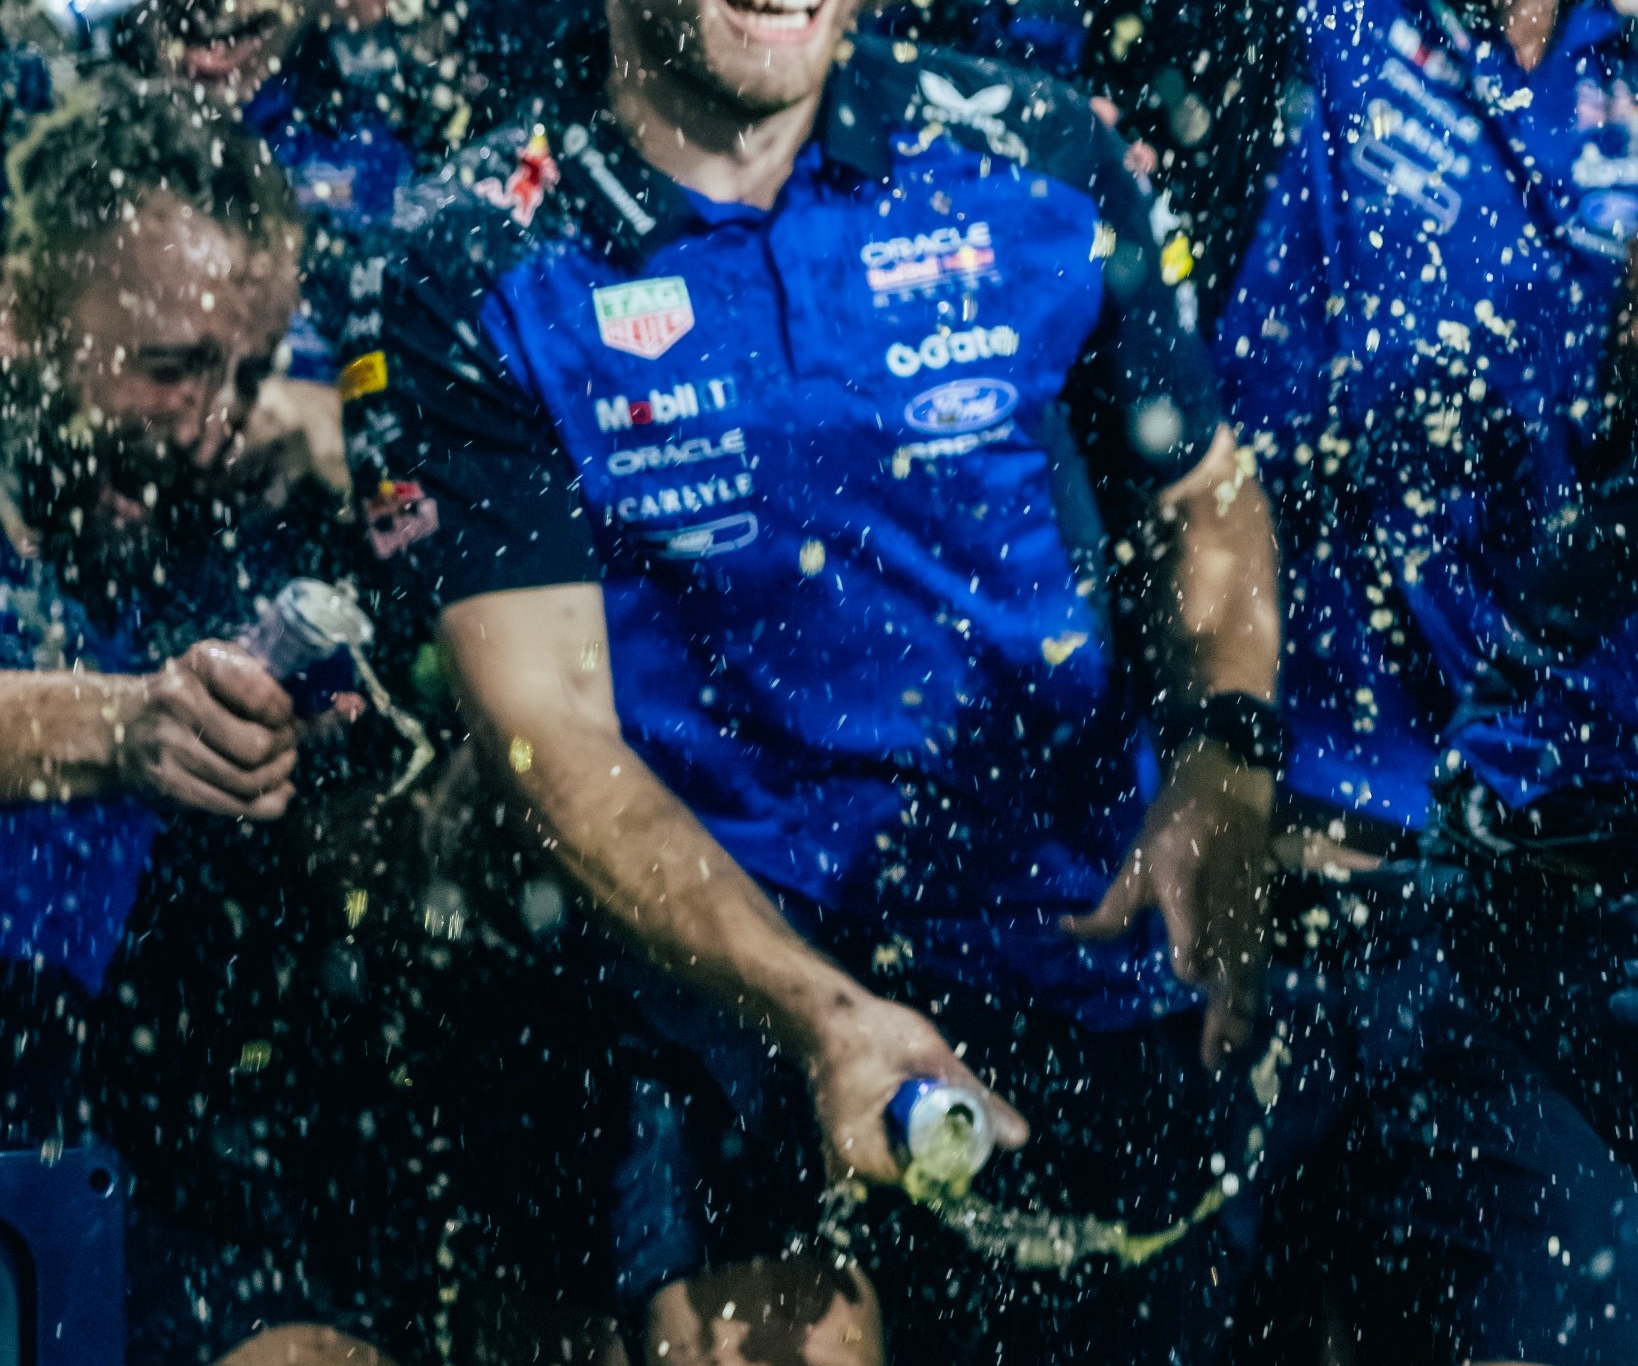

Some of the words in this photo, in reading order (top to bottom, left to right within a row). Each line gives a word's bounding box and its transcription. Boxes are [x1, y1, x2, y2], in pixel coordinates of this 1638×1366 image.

[595, 382, 699, 432] Mobil
[607, 427, 746, 476] ORACLE
[617, 472, 753, 521] CARLYLE
